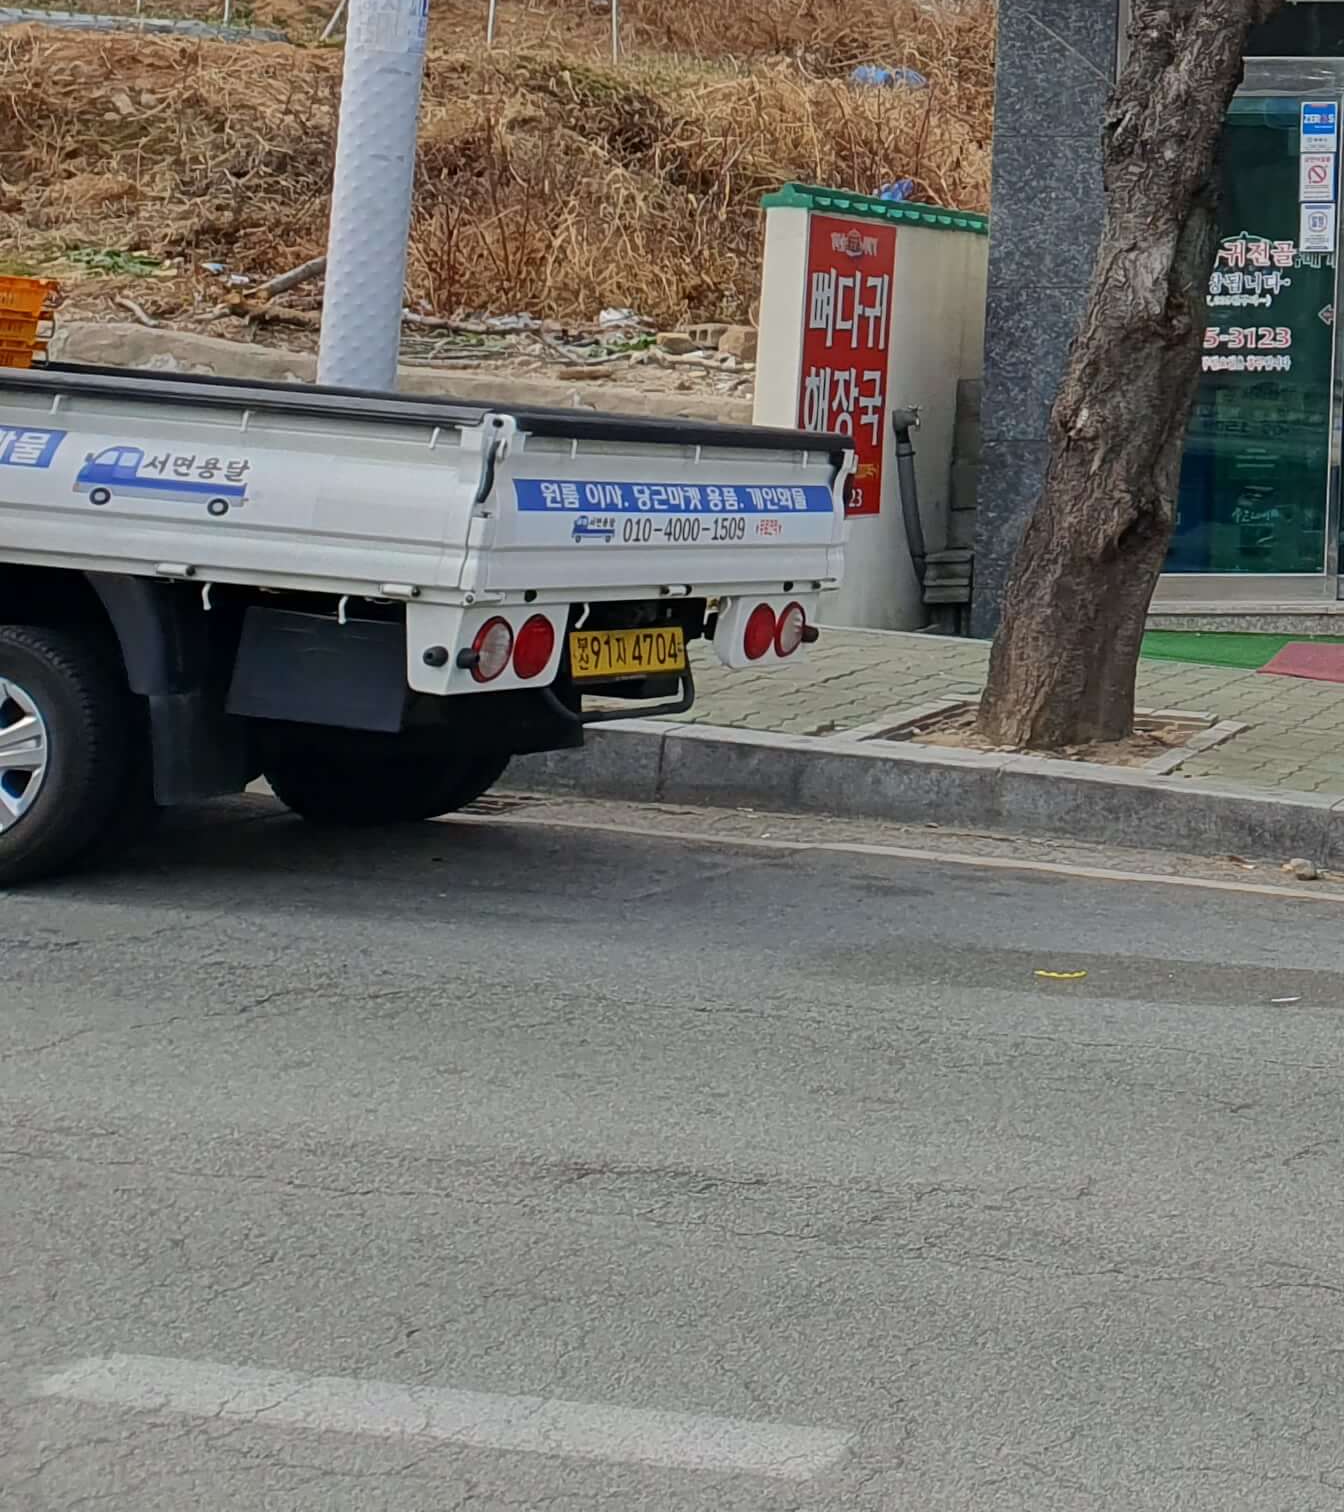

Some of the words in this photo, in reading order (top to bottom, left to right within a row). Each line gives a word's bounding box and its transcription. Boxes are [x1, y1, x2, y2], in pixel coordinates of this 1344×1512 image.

[808, 267, 889, 350] 뼈다귀
[804, 366, 883, 445] 해장국
[143, 453, 251, 483] 서면용달
[540, 481, 580, 509] 원룸
[632, 485, 703, 511] 당근마켓
[745, 487, 808, 511] 개인화물
[622, 517, 746, 543] 010-4000-1509
